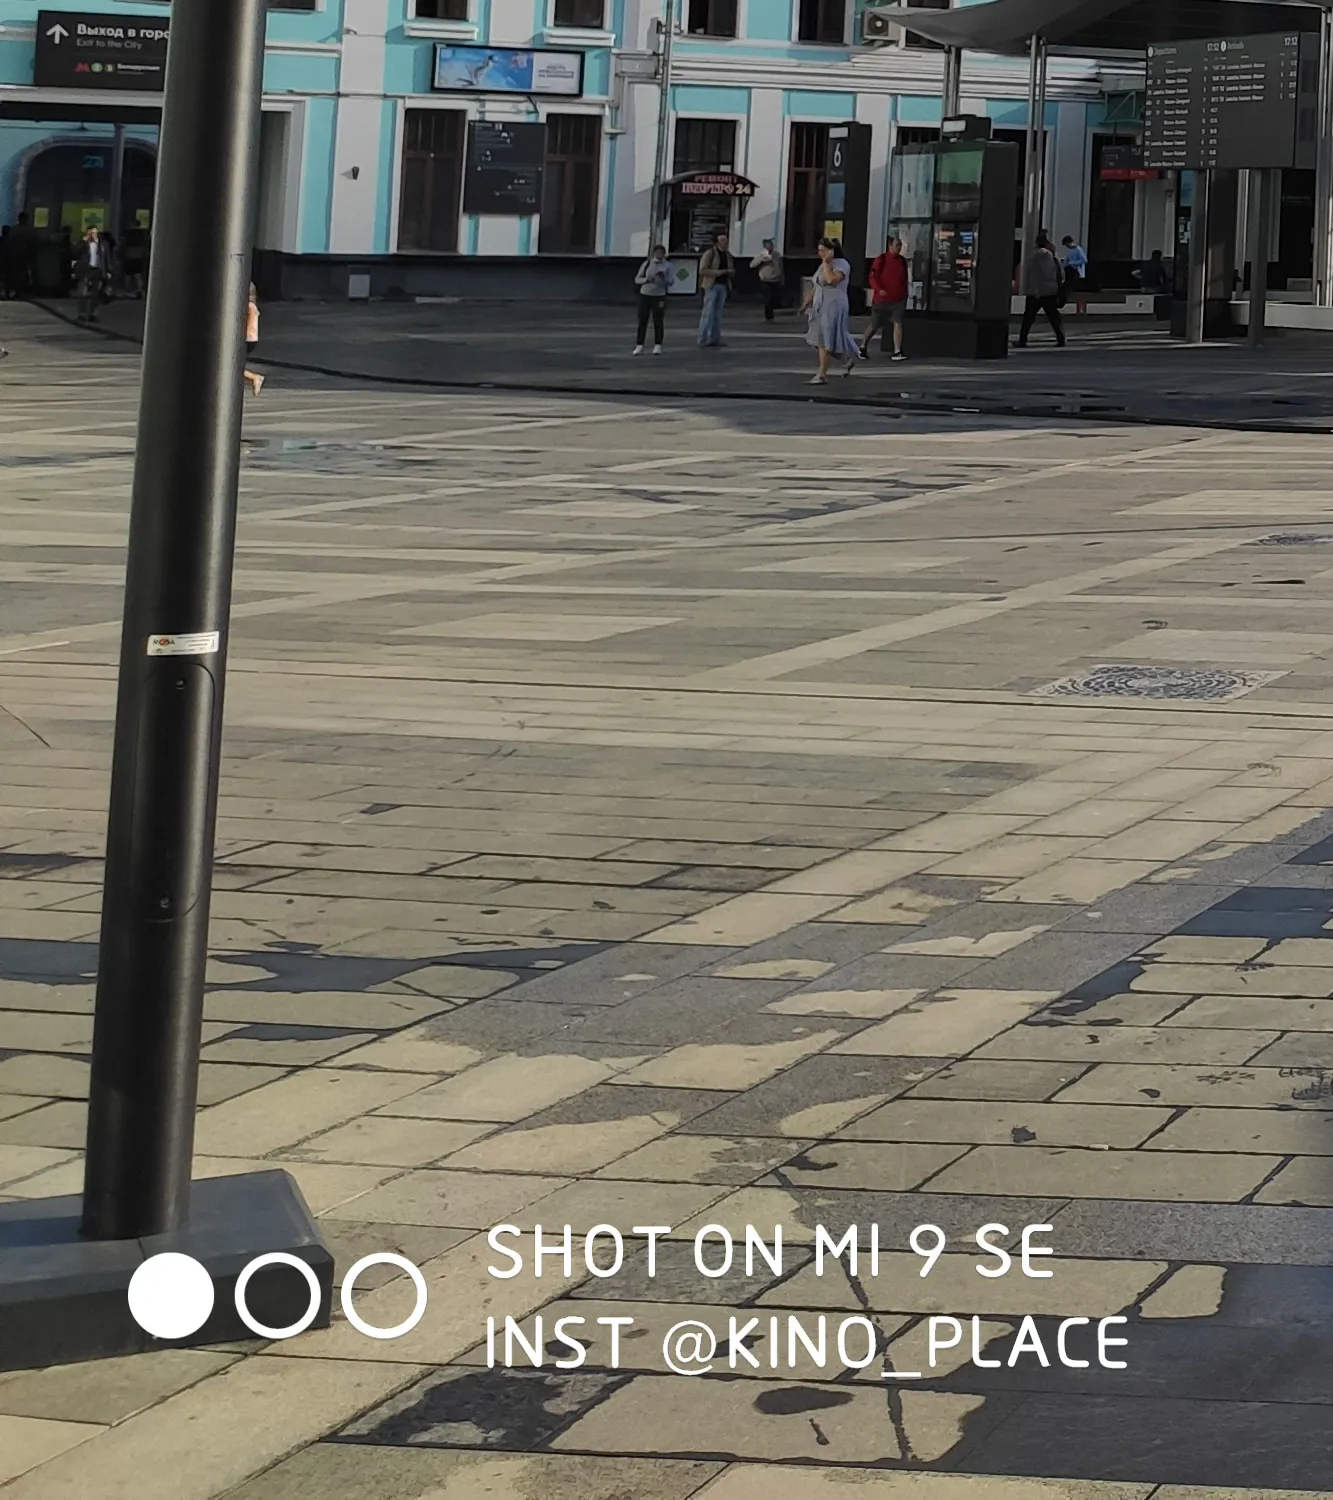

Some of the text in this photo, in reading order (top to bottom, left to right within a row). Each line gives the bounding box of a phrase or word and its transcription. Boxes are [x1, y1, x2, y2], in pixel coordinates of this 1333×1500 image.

[77, 23, 171, 40] Выход в горо
[124, 40, 142, 50] City
[834, 143, 841, 168] 6
[735, 183, 751, 194] 24
